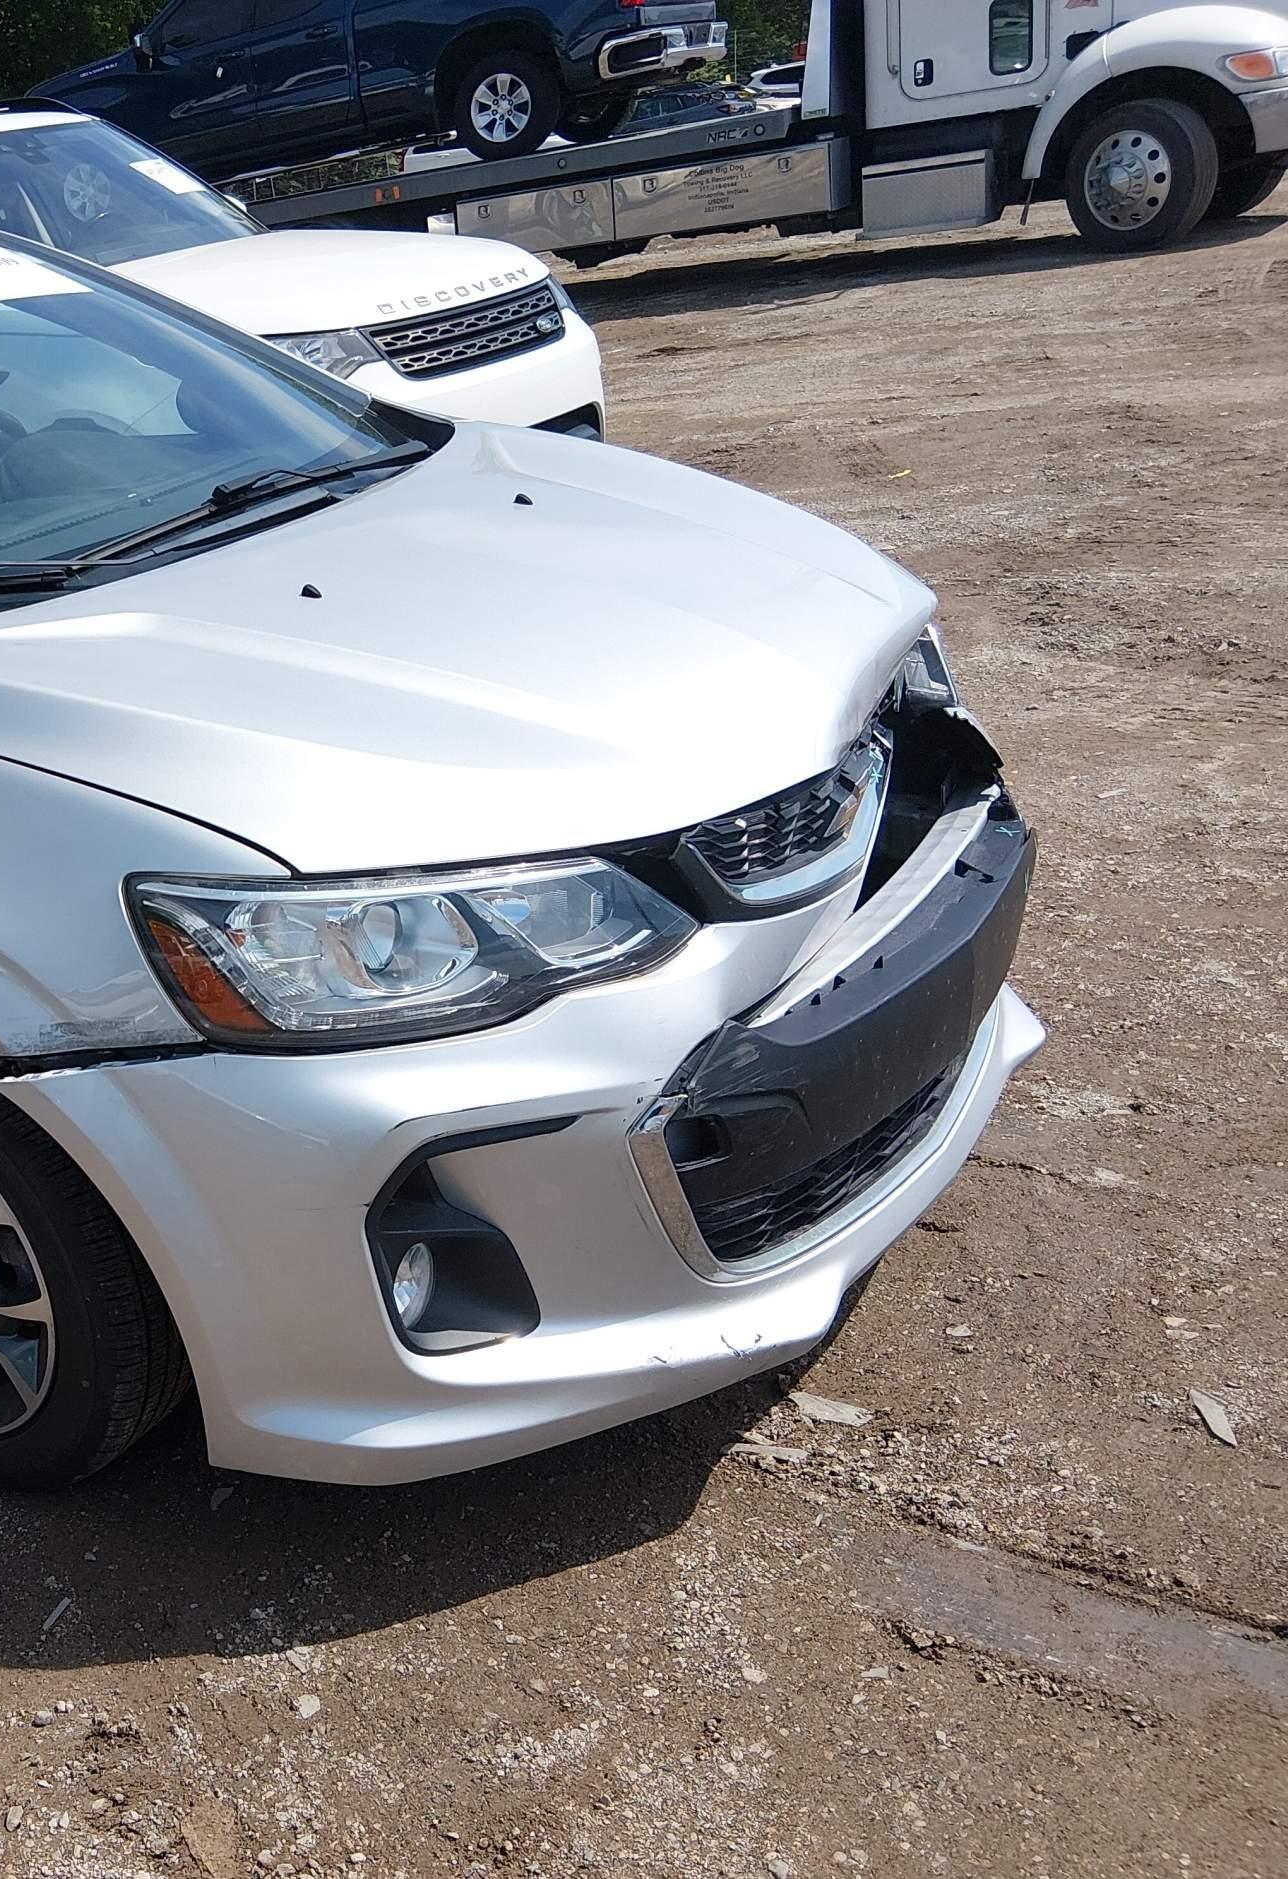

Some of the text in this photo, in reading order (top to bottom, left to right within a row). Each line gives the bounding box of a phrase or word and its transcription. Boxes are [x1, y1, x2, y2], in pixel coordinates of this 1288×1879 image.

[715, 166, 728, 174] Big
[729, 164, 744, 172] Dog
[740, 171, 753, 179] LLC
[377, 267, 529, 315] DISCOVERY
